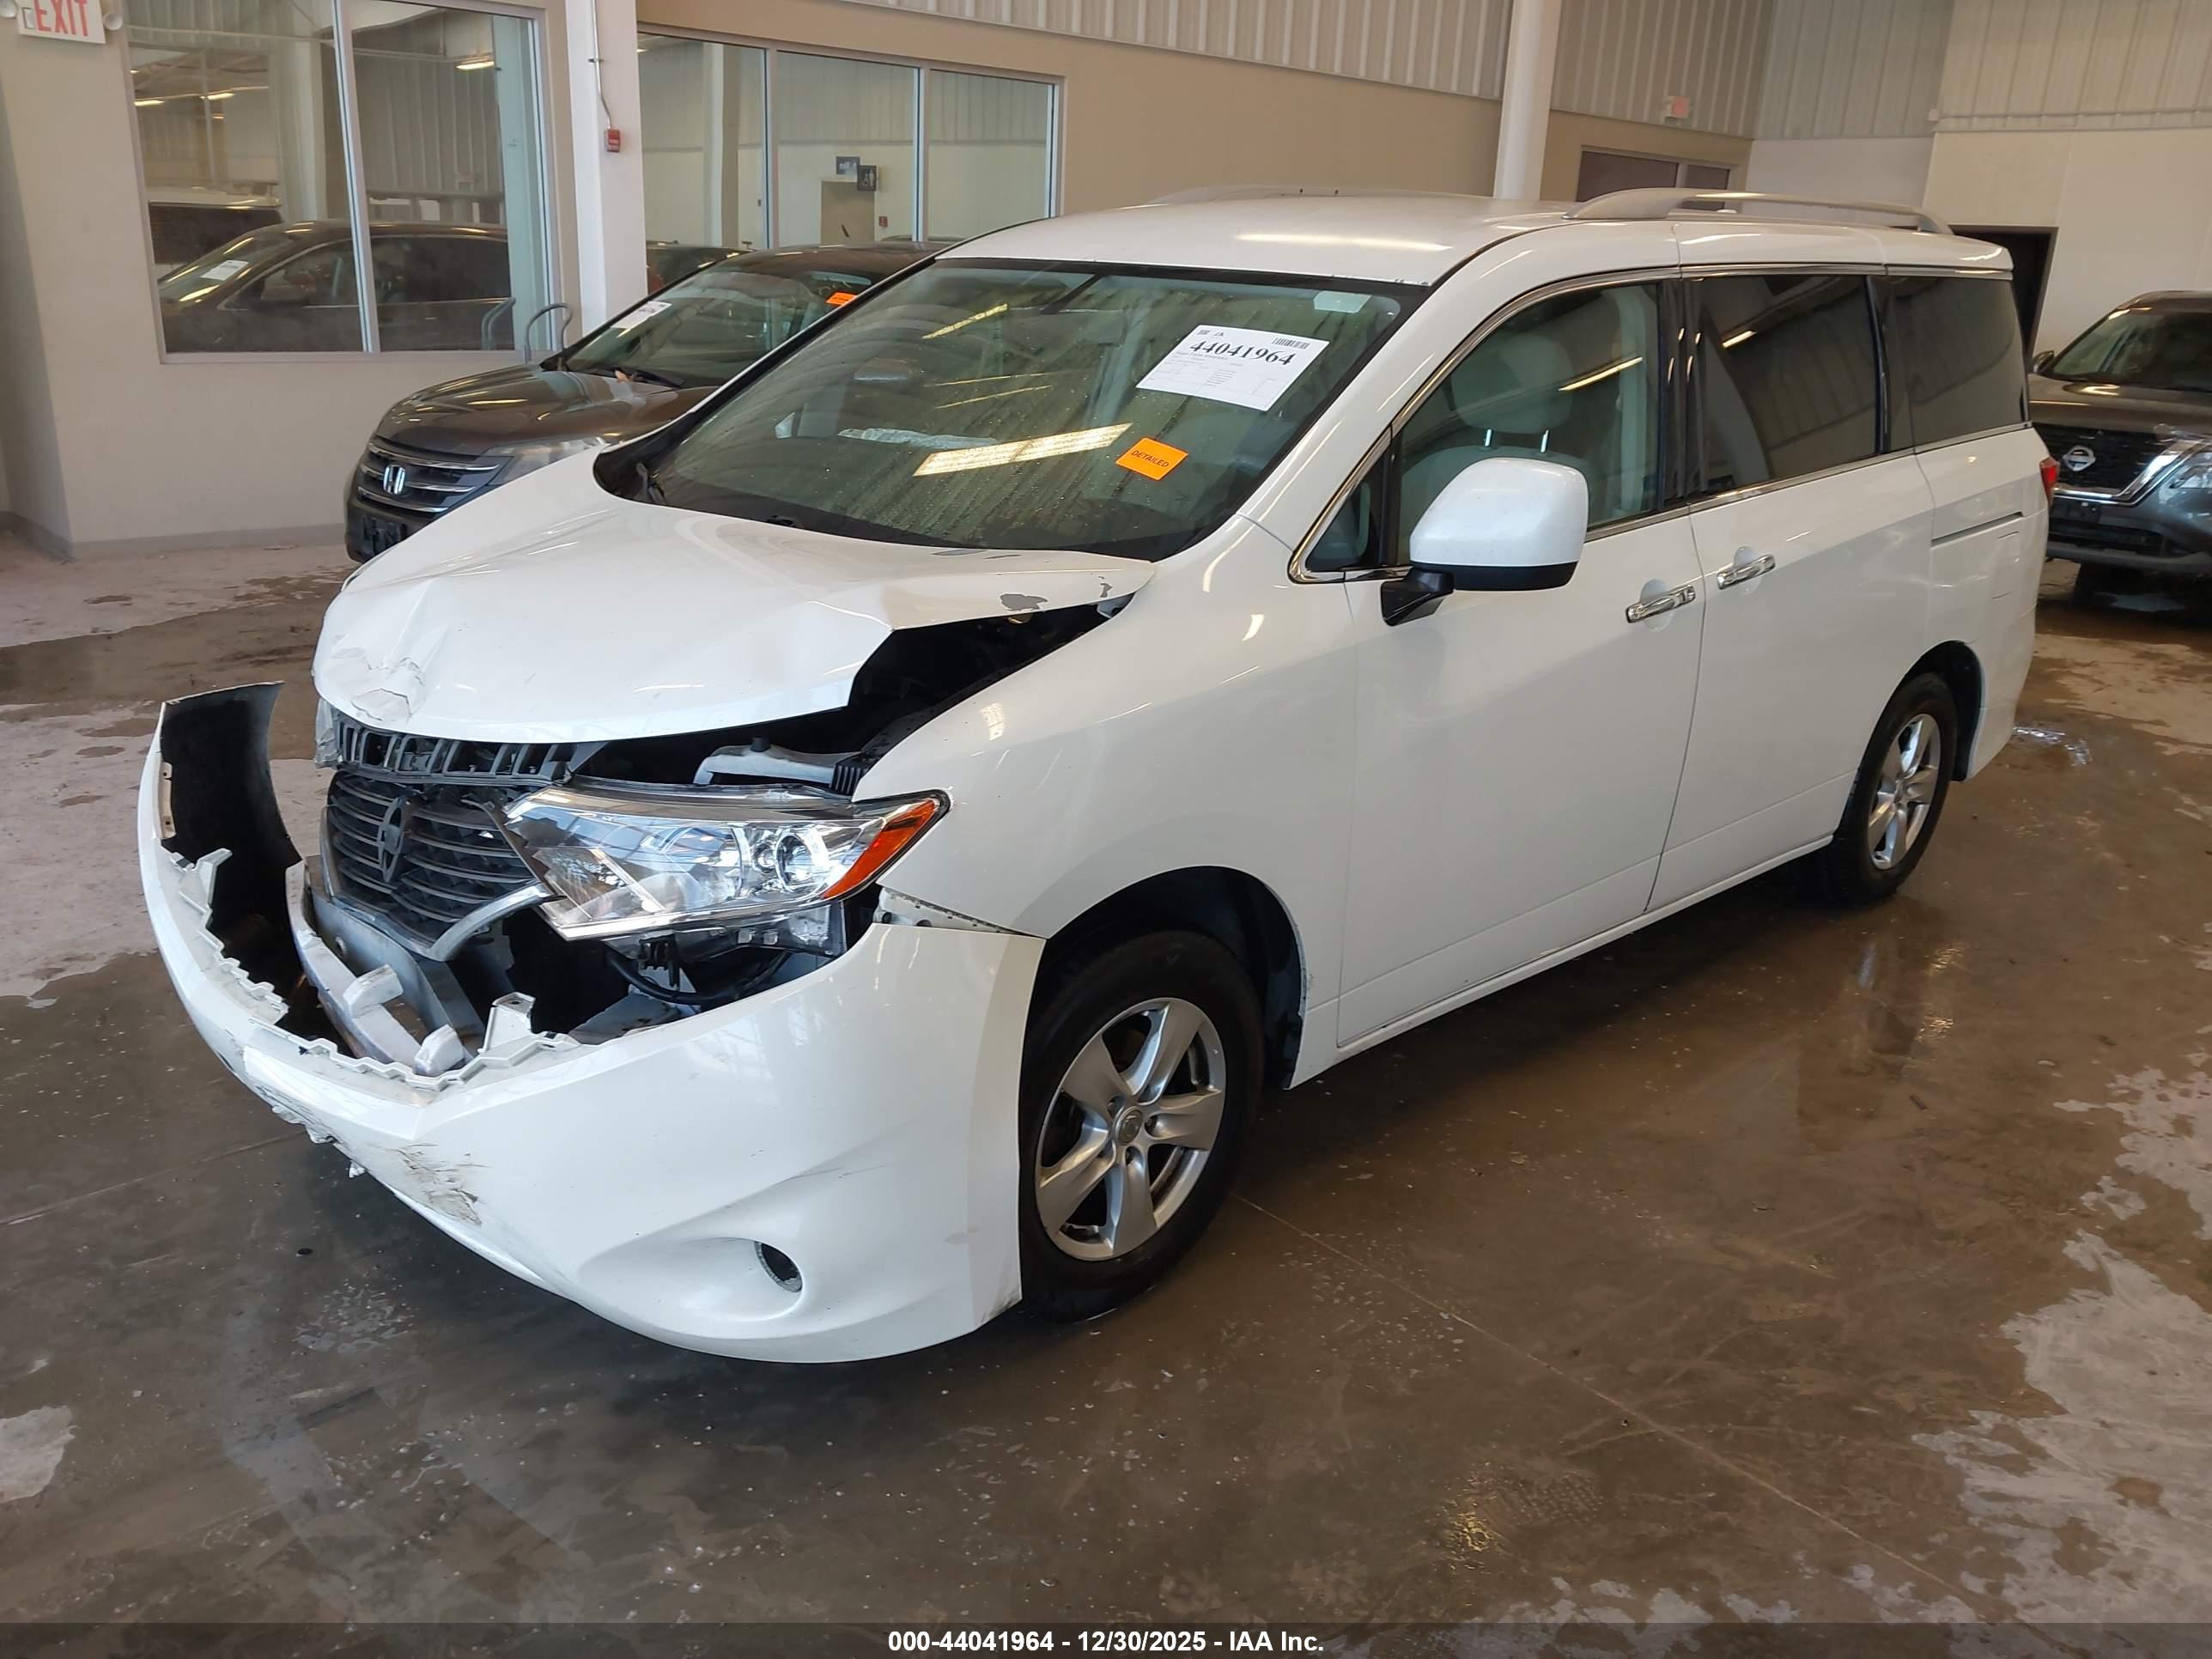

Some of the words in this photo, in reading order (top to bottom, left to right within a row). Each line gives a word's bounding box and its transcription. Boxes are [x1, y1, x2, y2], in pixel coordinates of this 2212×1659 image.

[33, 0, 89, 37] EXIT
[1189, 340, 1297, 366] 44041964
[1130, 450, 1170, 468] DETAILED
